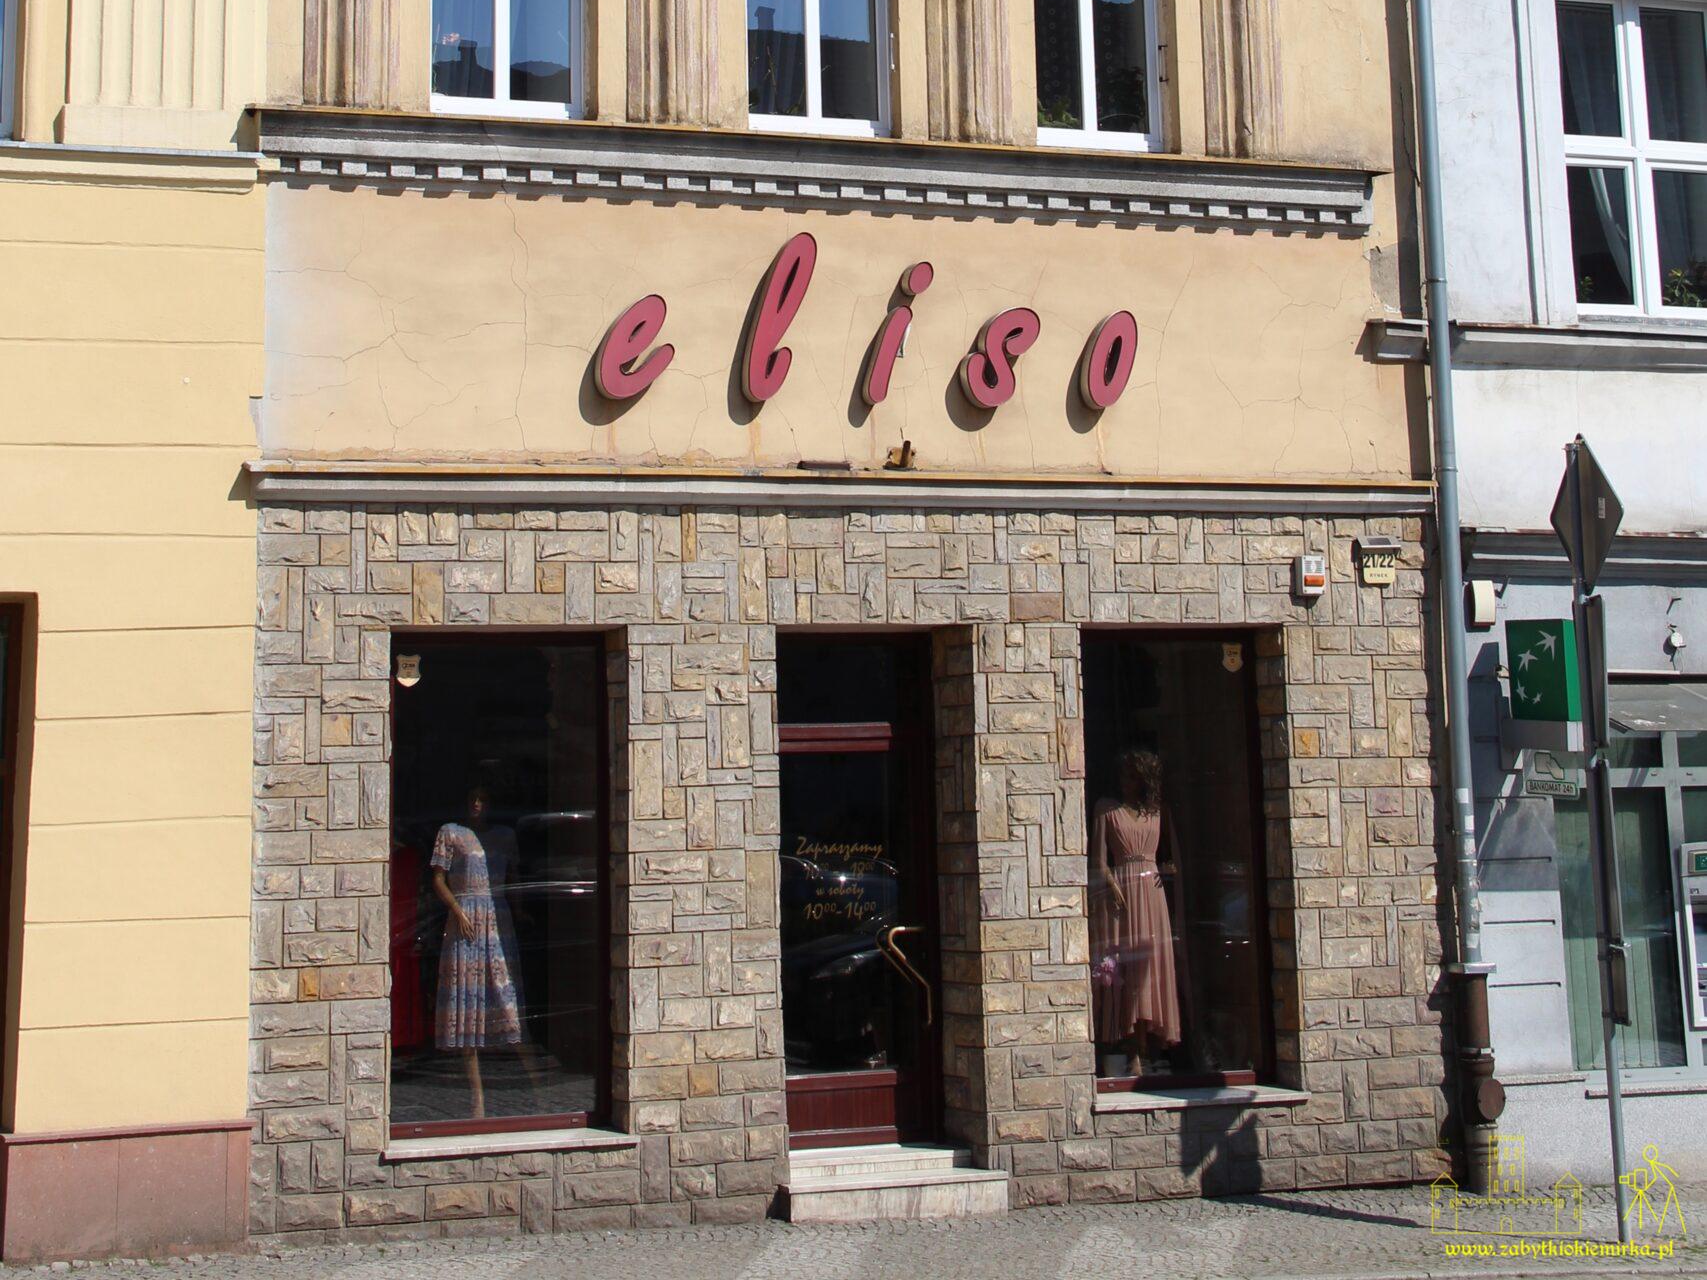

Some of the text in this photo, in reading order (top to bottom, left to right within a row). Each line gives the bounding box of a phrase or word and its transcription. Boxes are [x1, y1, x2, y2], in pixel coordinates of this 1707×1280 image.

[595, 231, 1139, 410] eliso
[1363, 553, 1394, 568] 21/22
[1529, 782, 1574, 793] BANKOMAT 24h
[796, 836, 884, 861] Zapraszamy
